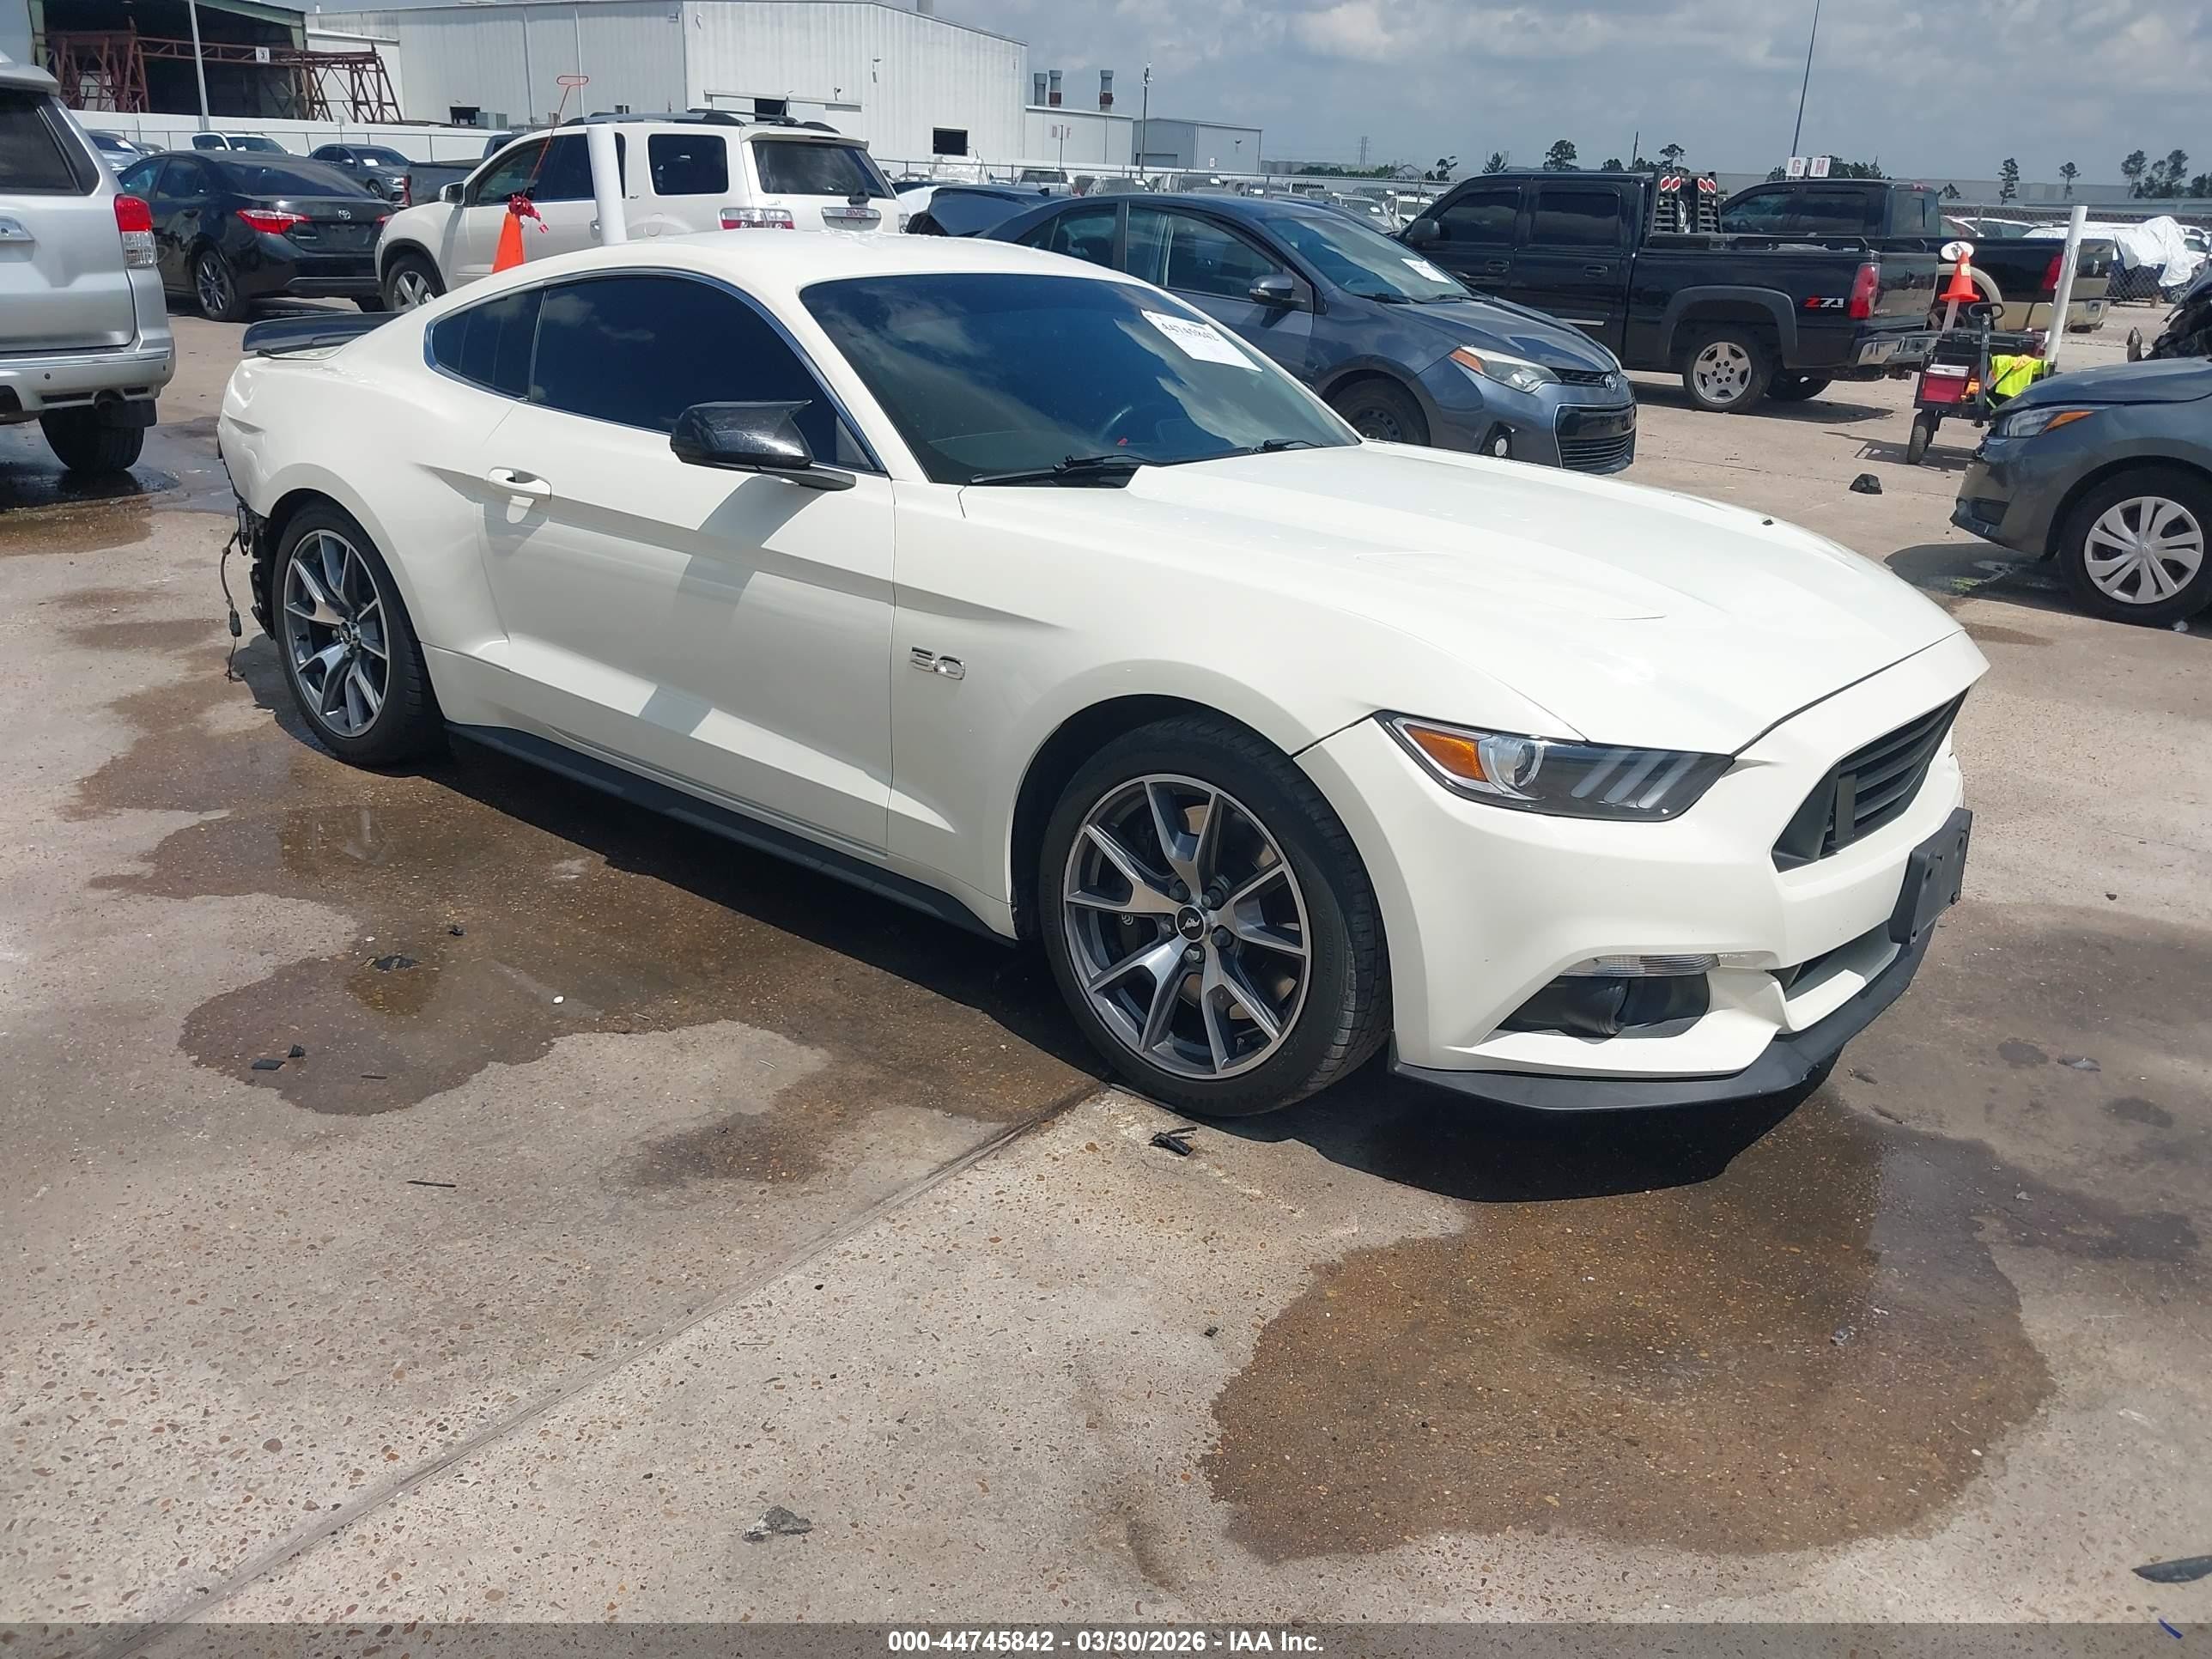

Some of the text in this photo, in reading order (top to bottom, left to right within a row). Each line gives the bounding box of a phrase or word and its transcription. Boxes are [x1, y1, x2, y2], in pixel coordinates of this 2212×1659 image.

[1791, 159, 1802, 174] G
[1814, 160, 1826, 175] H
[1804, 297, 1844, 308] Z71
[910, 646, 966, 681] 5.0
